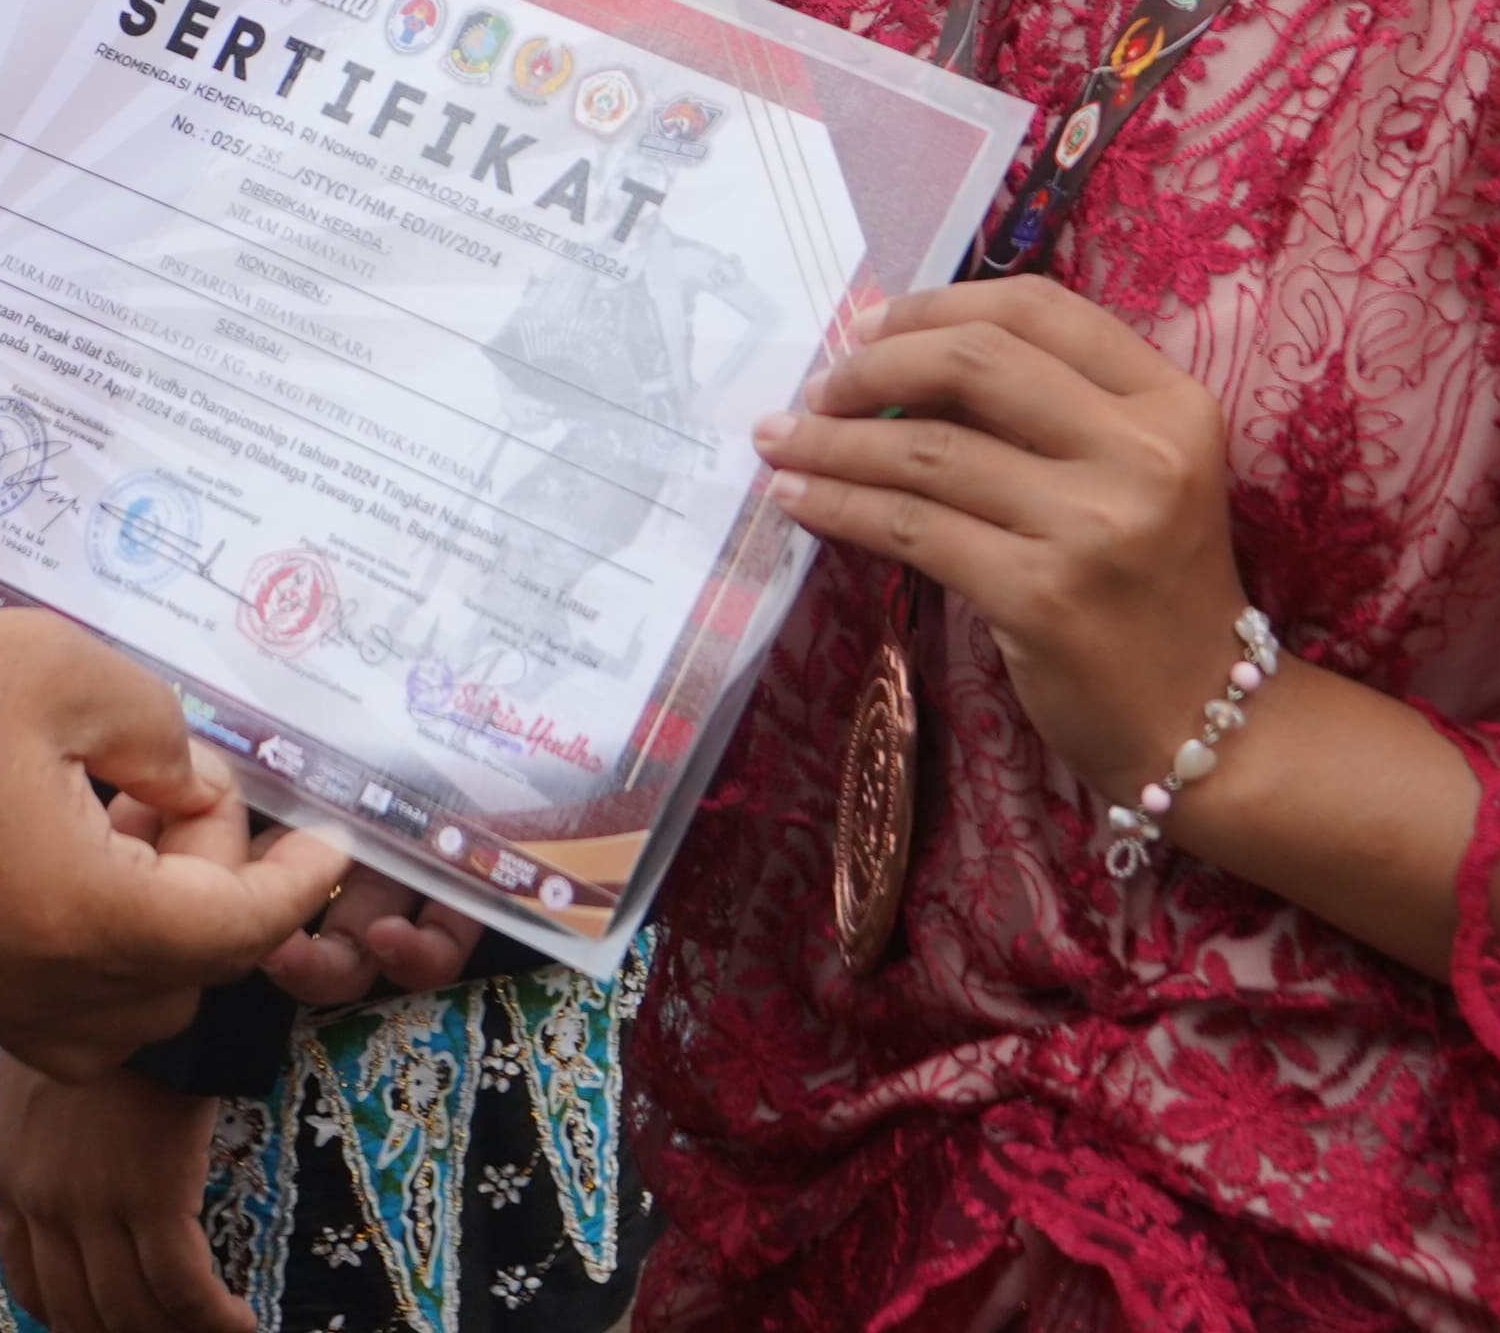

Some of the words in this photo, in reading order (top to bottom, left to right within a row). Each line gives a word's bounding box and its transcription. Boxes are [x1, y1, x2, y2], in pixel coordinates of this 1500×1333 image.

[170, 113, 202, 138] No.
[192, 81, 298, 137] KEMENPORA
[298, 126, 319, 144] RI
[223, 201, 280, 237] NILAM
[278, 225, 379, 280] DAMAYANTI
[238, 176, 321, 223] DIBERIKAN
[320, 212, 386, 251] KEPADA
[157, 253, 191, 280] IPSI
[188, 267, 255, 309] TARUNA
[251, 295, 378, 365] BHAYANGKARA
[234, 250, 326, 301] KONTINGEN
[212, 316, 285, 360] SEBAGAI
[45, 271, 66, 293] III
[61, 279, 132, 324] TANDING
[128, 309, 183, 347] KELAS
[179, 333, 197, 353] D
[217, 351, 247, 377] KG
[303, 391, 356, 428] PUTRI
[352, 415, 430, 463] TINGKAT
[425, 449, 498, 496] REMAJA
[22, 313, 73, 347] Pencak
[70, 334, 105, 361] Silat
[101, 348, 145, 380] Satria
[142, 367, 190, 401] Yudha
[186, 388, 291, 451] Championship
[296, 439, 343, 472] tahun
[339, 459, 381, 490] 2024
[377, 478, 439, 521] Tingkat
[435, 505, 507, 550] Nasional
[28, 343, 84, 381] Tanggal
[82, 367, 104, 387] 27
[100, 376, 137, 406] April
[134, 391, 173, 420] 2024
[170, 408, 189, 427] di
[185, 416, 245, 457] Gedung
[241, 441, 310, 487] Olahraga
[307, 473, 367, 515] Tawang
[402, 518, 500, 579] Banyuwangi
[508, 568, 553, 601] Jawa
[550, 588, 602, 625] Timur
